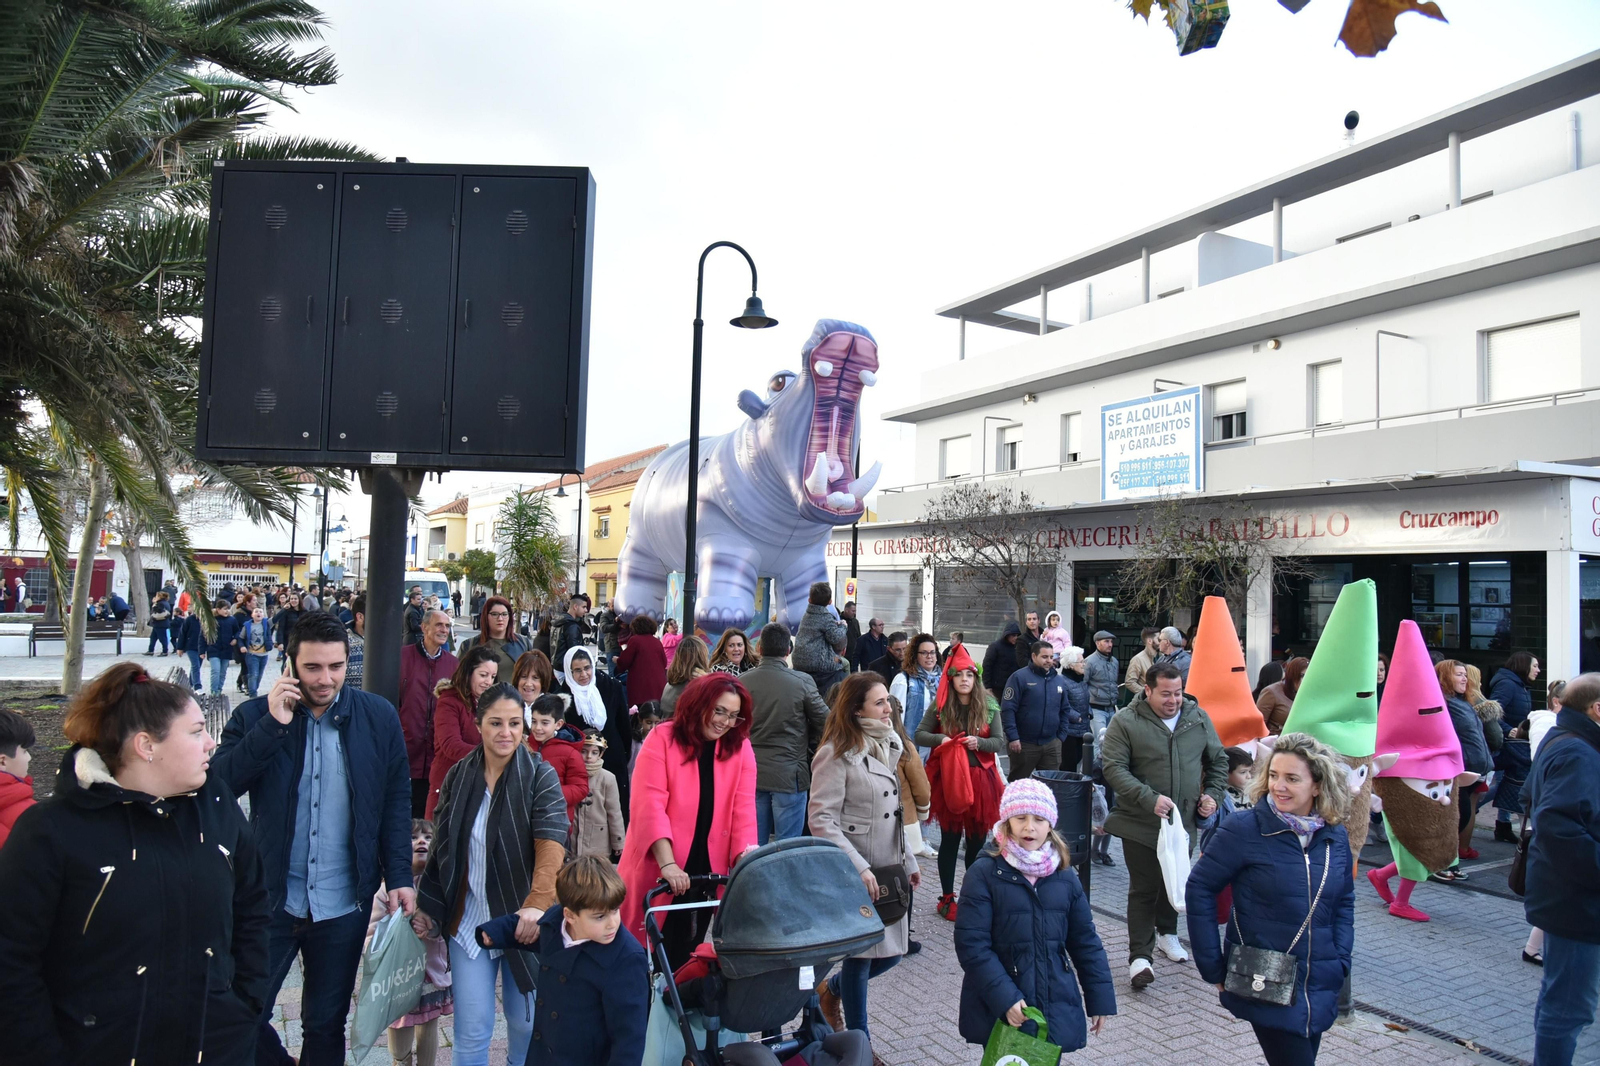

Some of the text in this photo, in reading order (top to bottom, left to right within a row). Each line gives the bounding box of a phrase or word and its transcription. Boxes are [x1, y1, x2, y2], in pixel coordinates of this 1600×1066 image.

[1108, 399, 1192, 427] SE ALQUILAN
[1108, 417, 1191, 441] APARTAMENTOS
[1120, 433, 1177, 455] y GARAJES
[1178, 457, 1189, 468] 307
[1400, 509, 1499, 529] Cruzcampo
